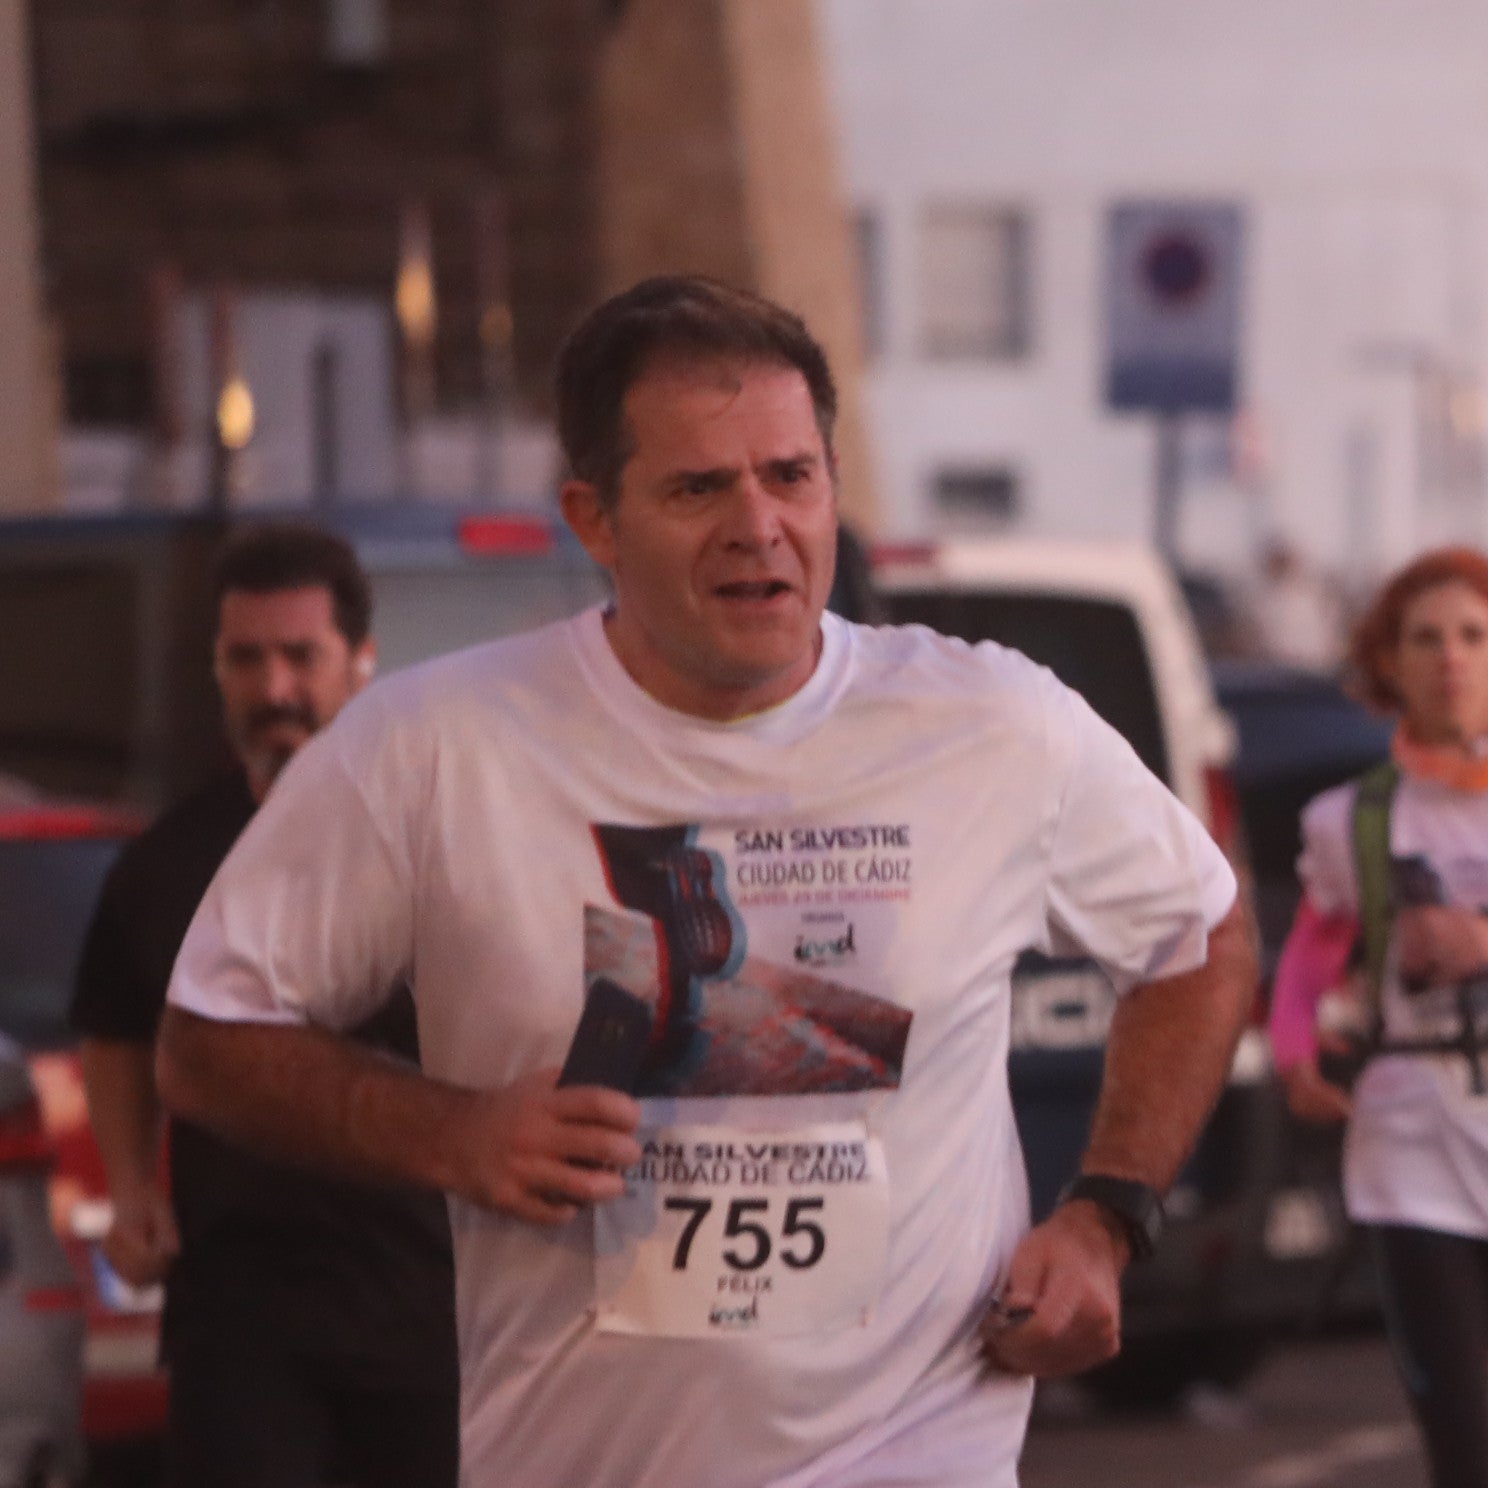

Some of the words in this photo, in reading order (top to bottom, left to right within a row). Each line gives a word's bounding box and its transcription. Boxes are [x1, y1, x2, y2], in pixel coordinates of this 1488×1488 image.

[735, 829, 783, 853] SAN
[790, 825, 910, 851] SILVESTRE
[736, 860, 816, 887] CIUDAD
[822, 859, 847, 884] DE
[854, 856, 911, 883] CÁDIZ
[640, 1141, 685, 1160] AN
[740, 1161, 778, 1185] DE
[664, 1195, 827, 1272] 755
